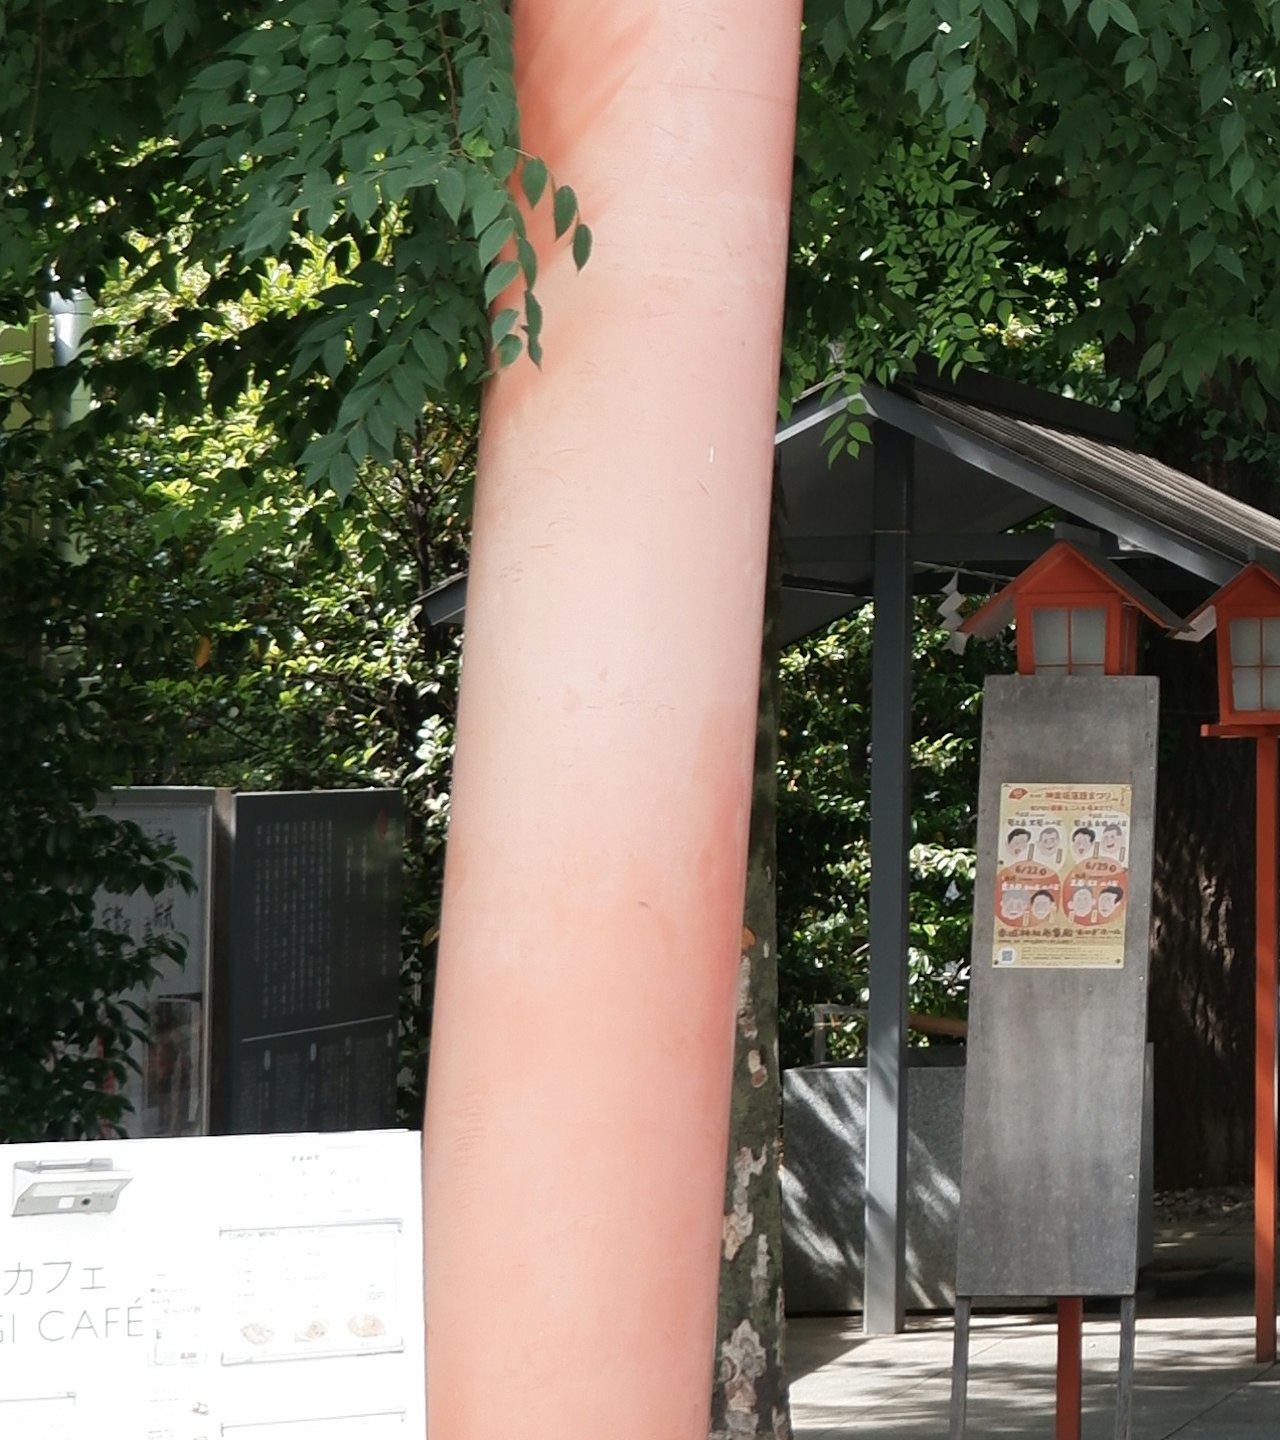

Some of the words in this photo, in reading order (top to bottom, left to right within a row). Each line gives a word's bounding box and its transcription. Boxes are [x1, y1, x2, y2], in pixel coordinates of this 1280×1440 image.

[3, 1261, 107, 1296] カフェ
[38, 1296, 144, 1342] CAFÉ
